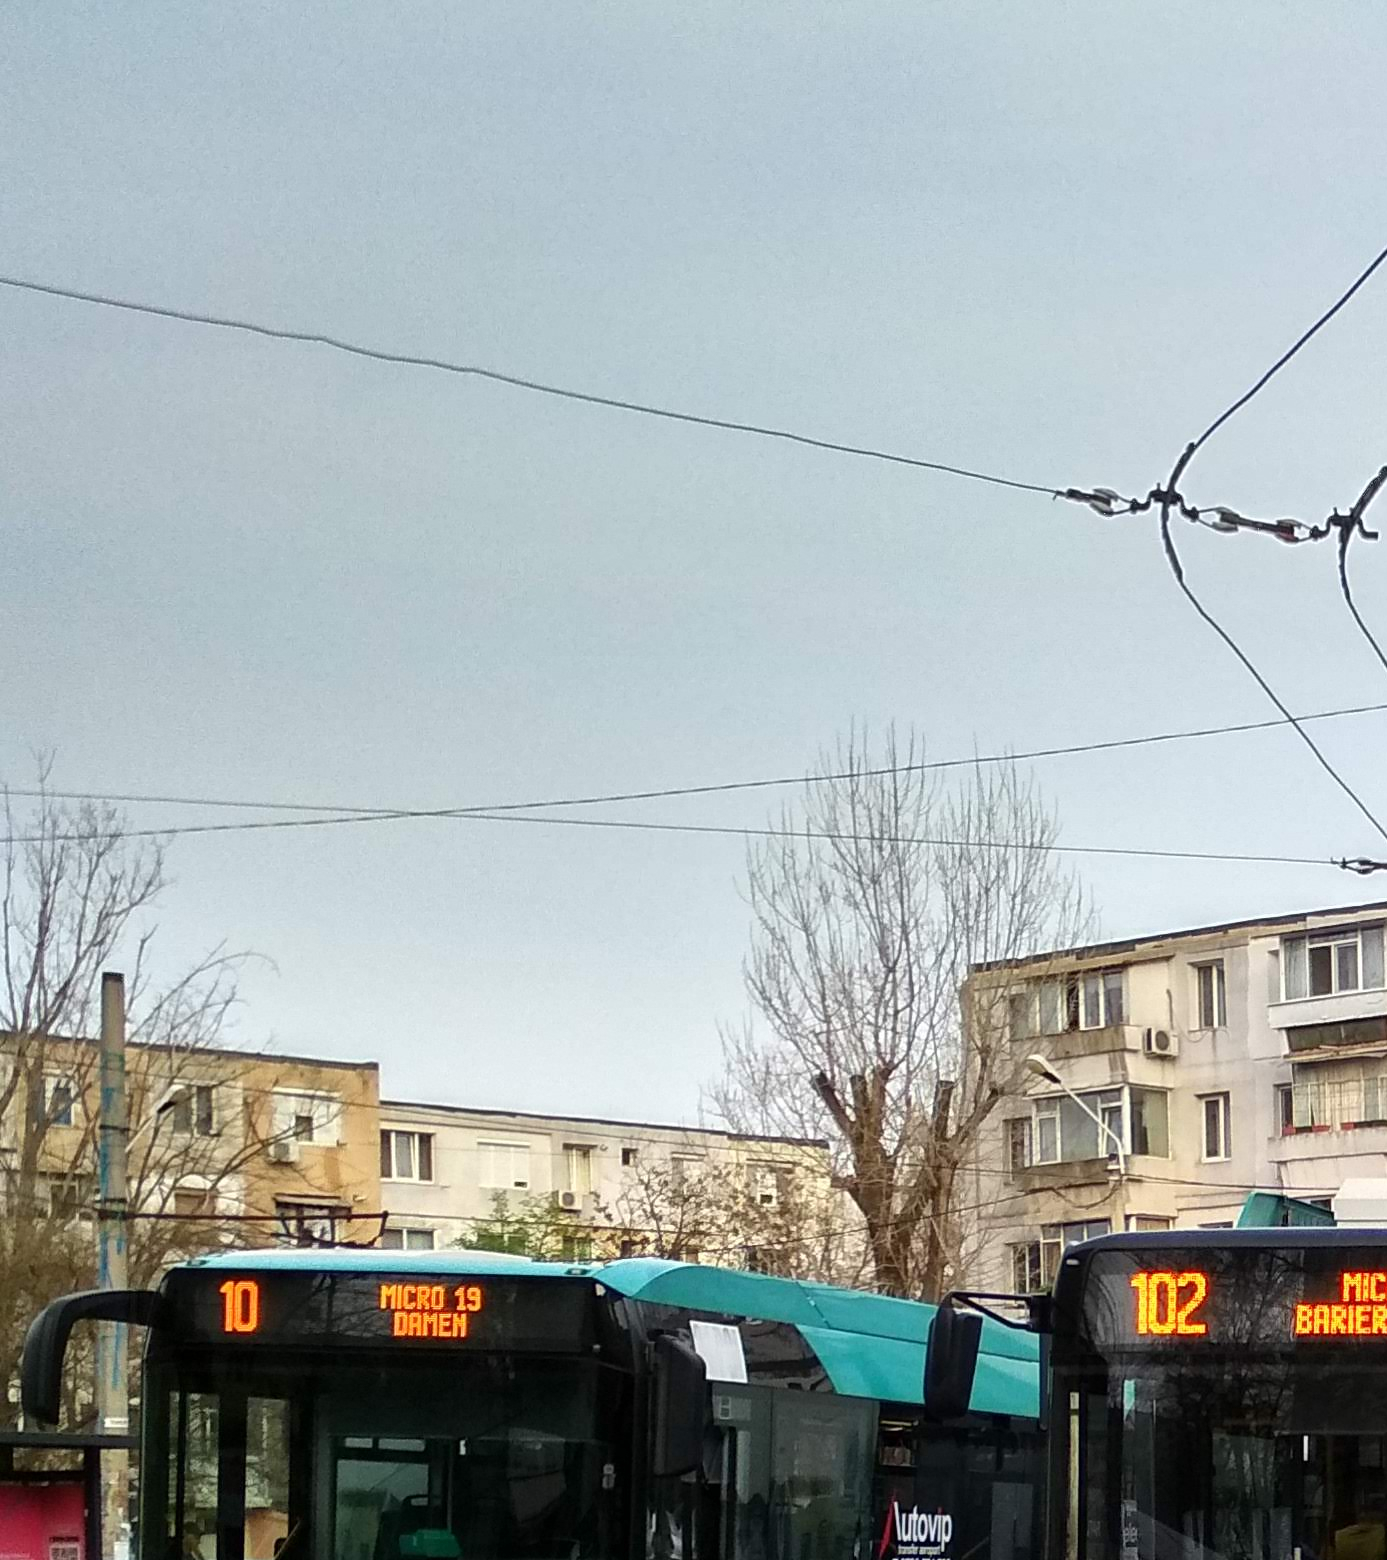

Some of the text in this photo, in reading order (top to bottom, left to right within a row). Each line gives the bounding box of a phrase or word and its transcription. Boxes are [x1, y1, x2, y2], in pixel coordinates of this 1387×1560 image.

[219, 1281, 259, 1333] 10
[380, 1284, 482, 1312] MICRO 19
[1131, 1273, 1207, 1334] 102
[393, 1312, 468, 1338] DAMEN
[879, 1496, 953, 1553] Autovip
